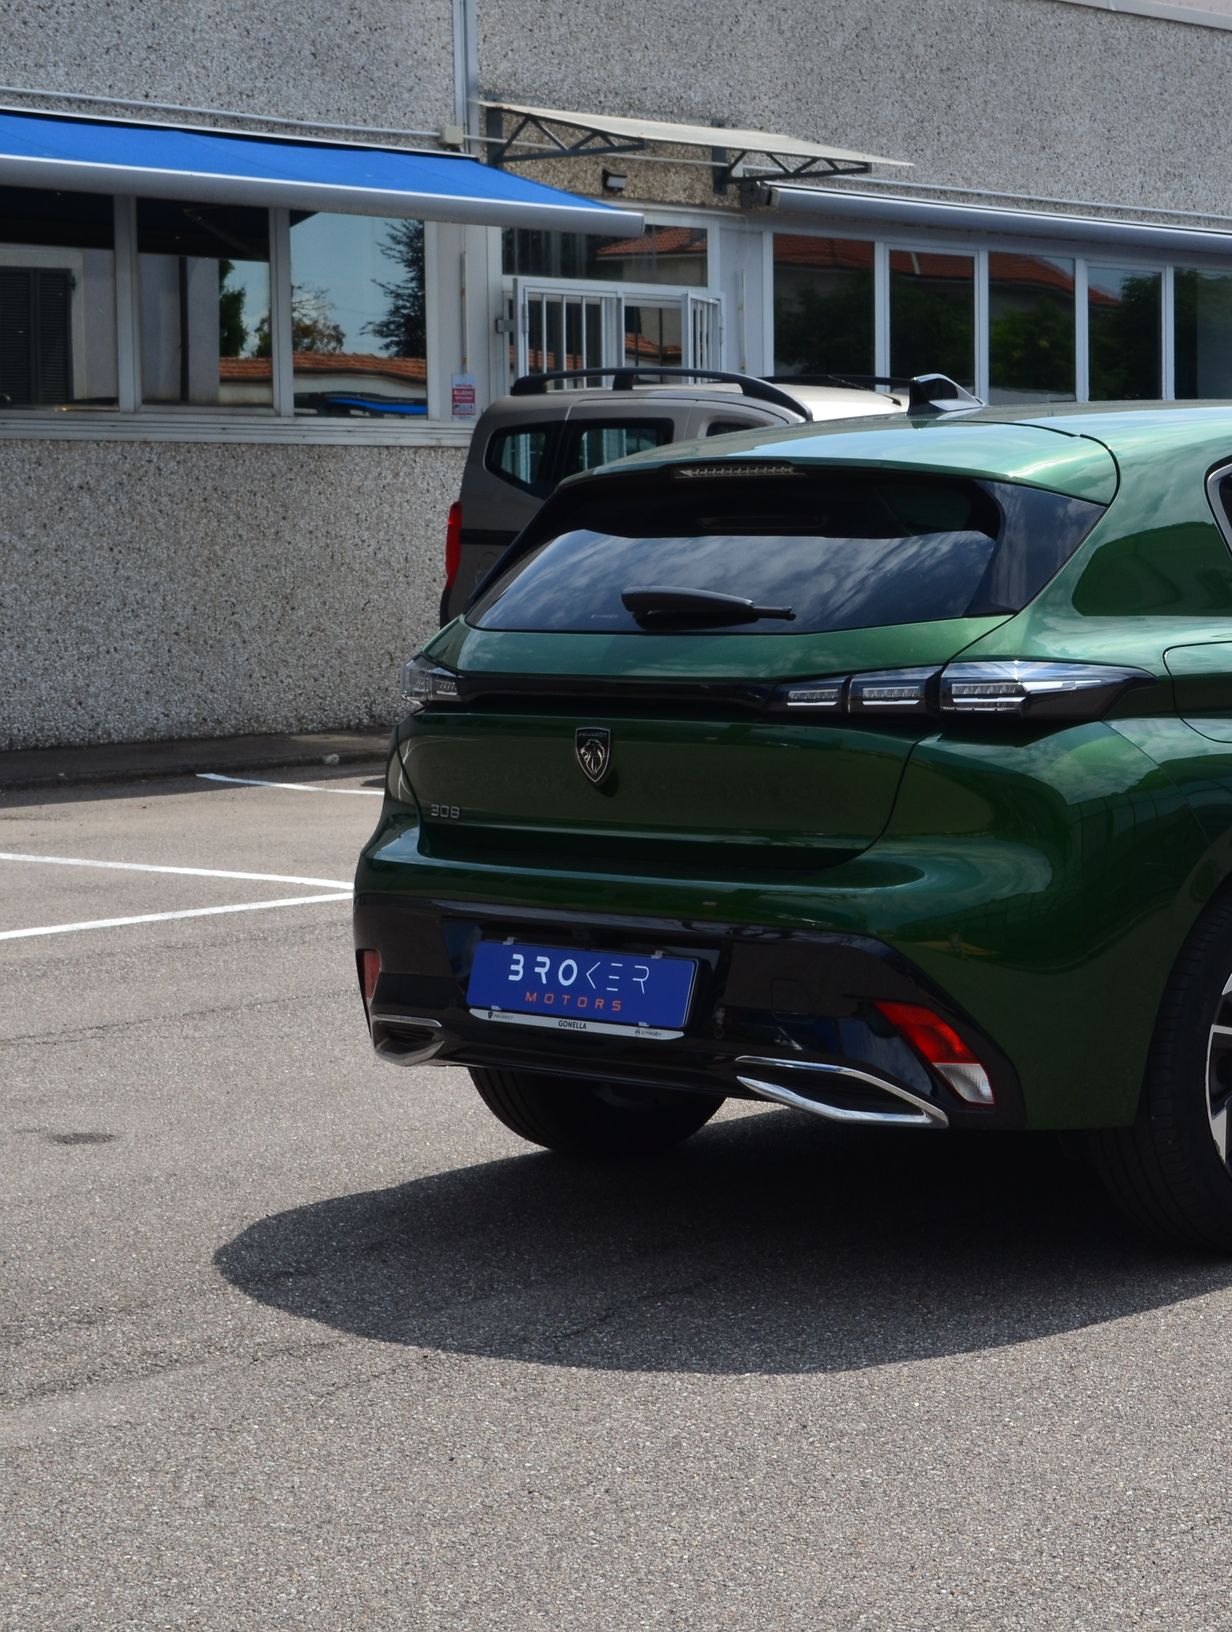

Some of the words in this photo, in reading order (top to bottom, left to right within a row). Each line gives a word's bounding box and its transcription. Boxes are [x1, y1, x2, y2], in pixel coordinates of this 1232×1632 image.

[431, 804, 460, 818] 308
[508, 954, 650, 994] BROKER
[525, 992, 621, 1011] MOTORS
[558, 1019, 587, 1030] GONELLA
